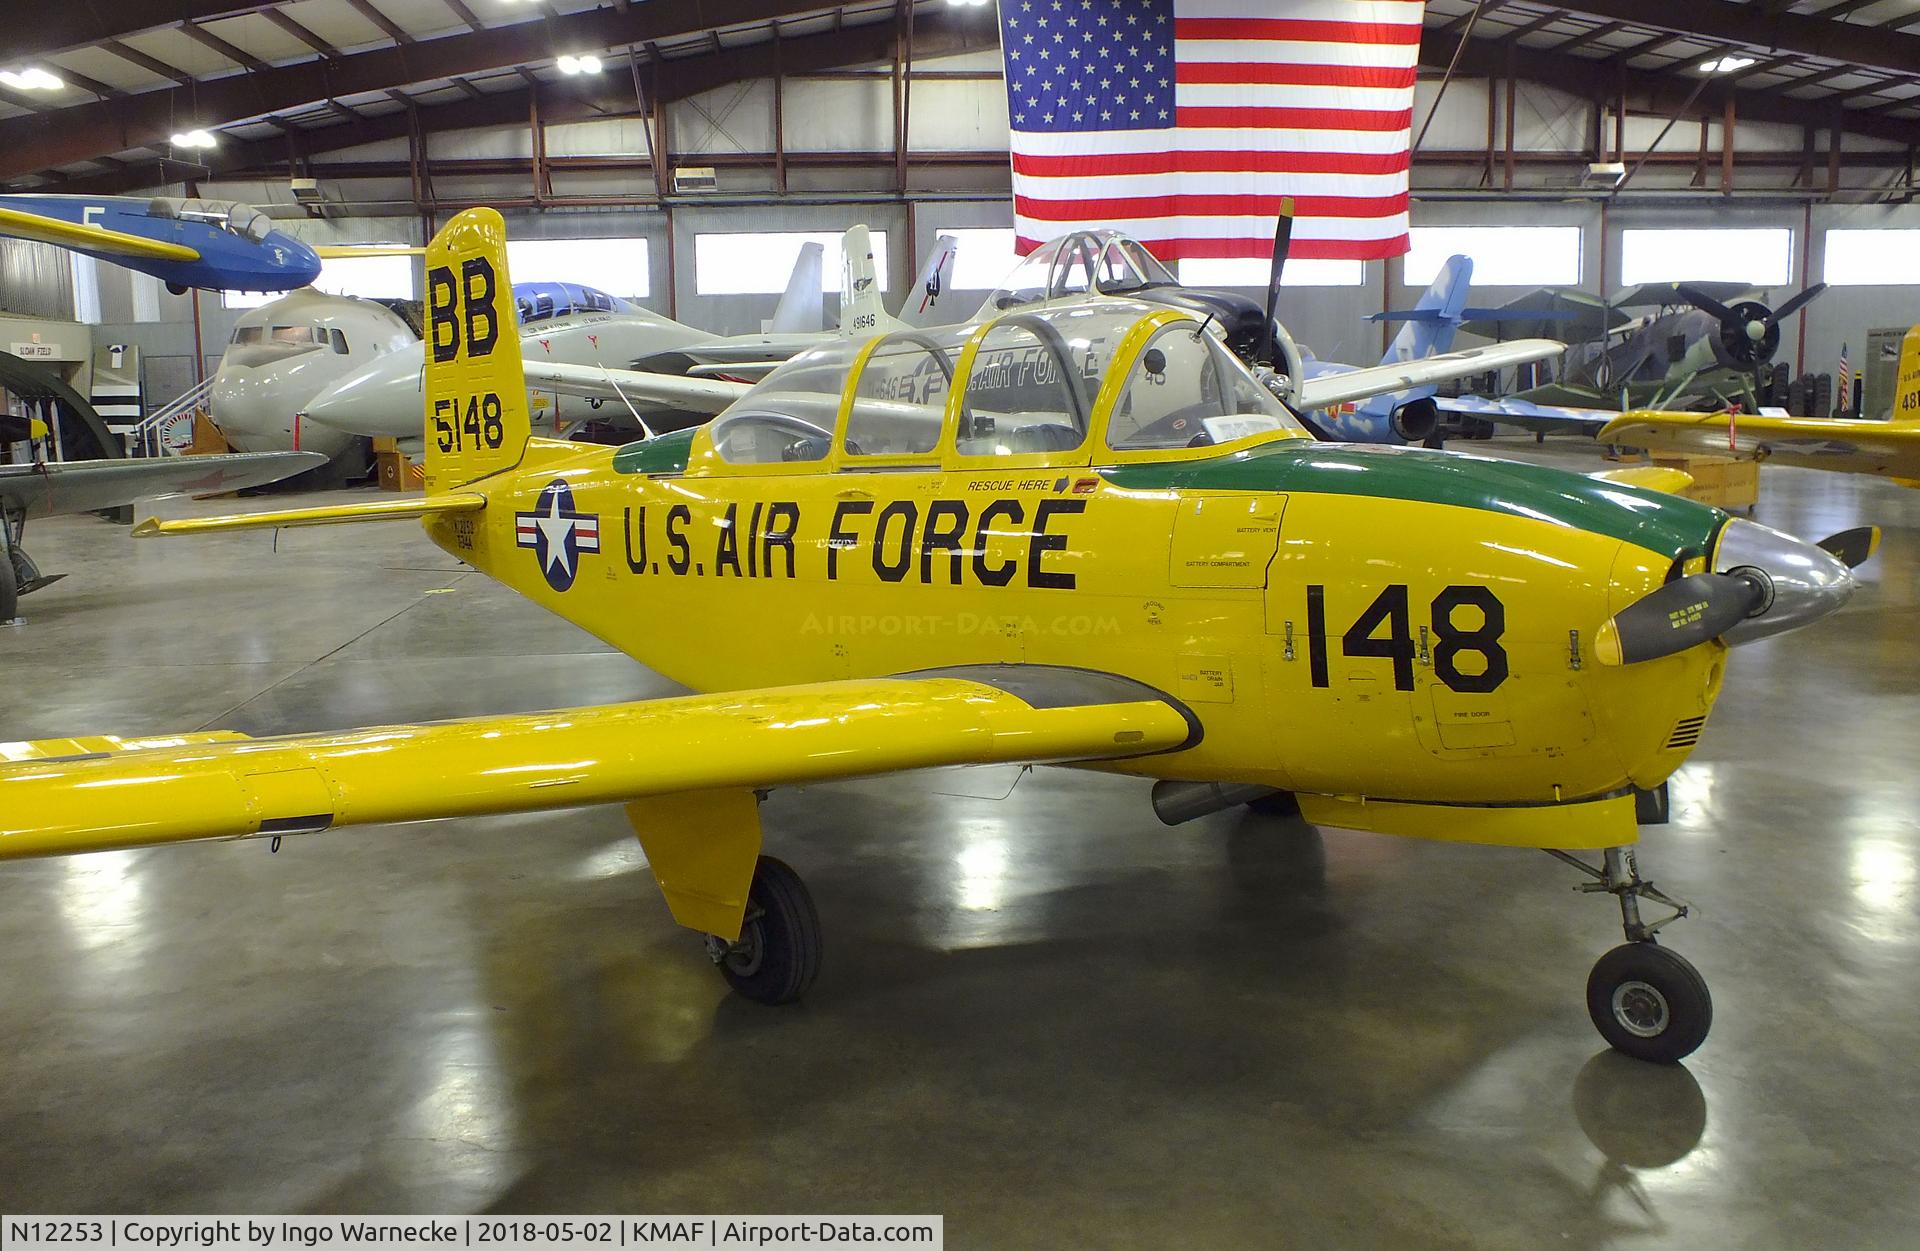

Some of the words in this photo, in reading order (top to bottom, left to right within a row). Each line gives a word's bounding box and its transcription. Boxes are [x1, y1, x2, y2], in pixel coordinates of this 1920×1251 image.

[429, 256, 499, 364] BB
[37, 346, 52, 356] FIELD
[434, 393, 504, 453] 5148
[1902, 390, 1920, 411] 48
[967, 480, 1014, 492] RESCUE
[1017, 479, 1051, 491] HERE
[623, 503, 704, 576] U.S.
[715, 501, 801, 579] AIR
[827, 499, 1088, 590] FORCE
[1306, 584, 1509, 693] 148
